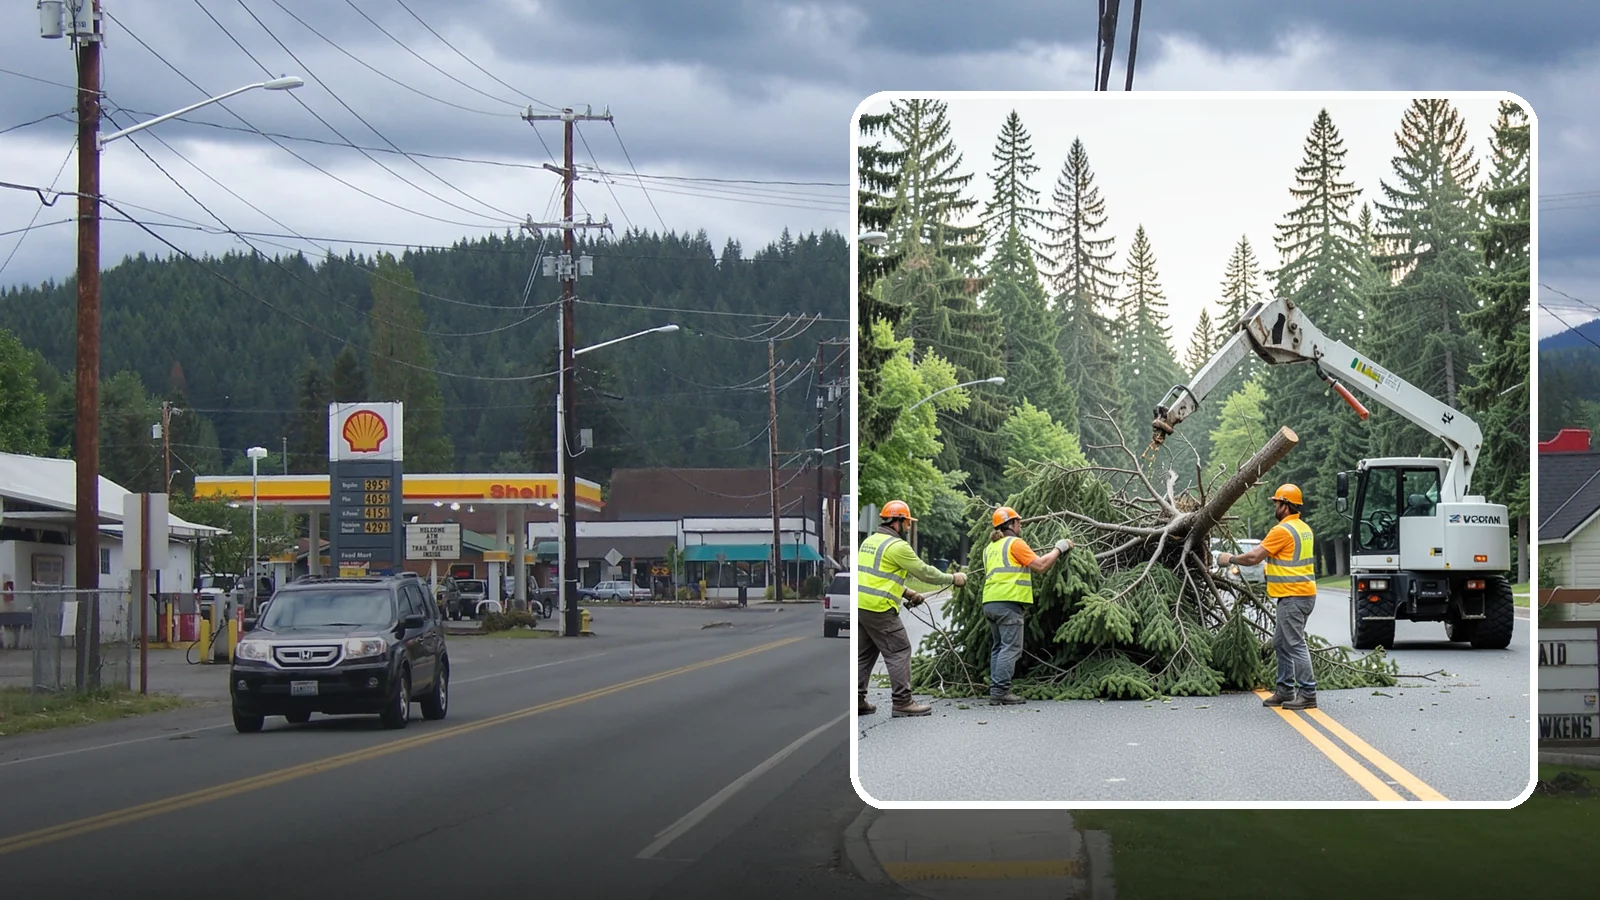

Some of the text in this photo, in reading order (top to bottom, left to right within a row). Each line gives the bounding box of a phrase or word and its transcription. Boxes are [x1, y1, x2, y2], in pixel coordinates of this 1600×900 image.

[366, 480, 384, 490] 395
[490, 484, 547, 499] Shell
[366, 494, 384, 504] 405
[366, 508, 384, 518] 415
[366, 522, 384, 532] 429
[1538, 643, 1567, 665] AID
